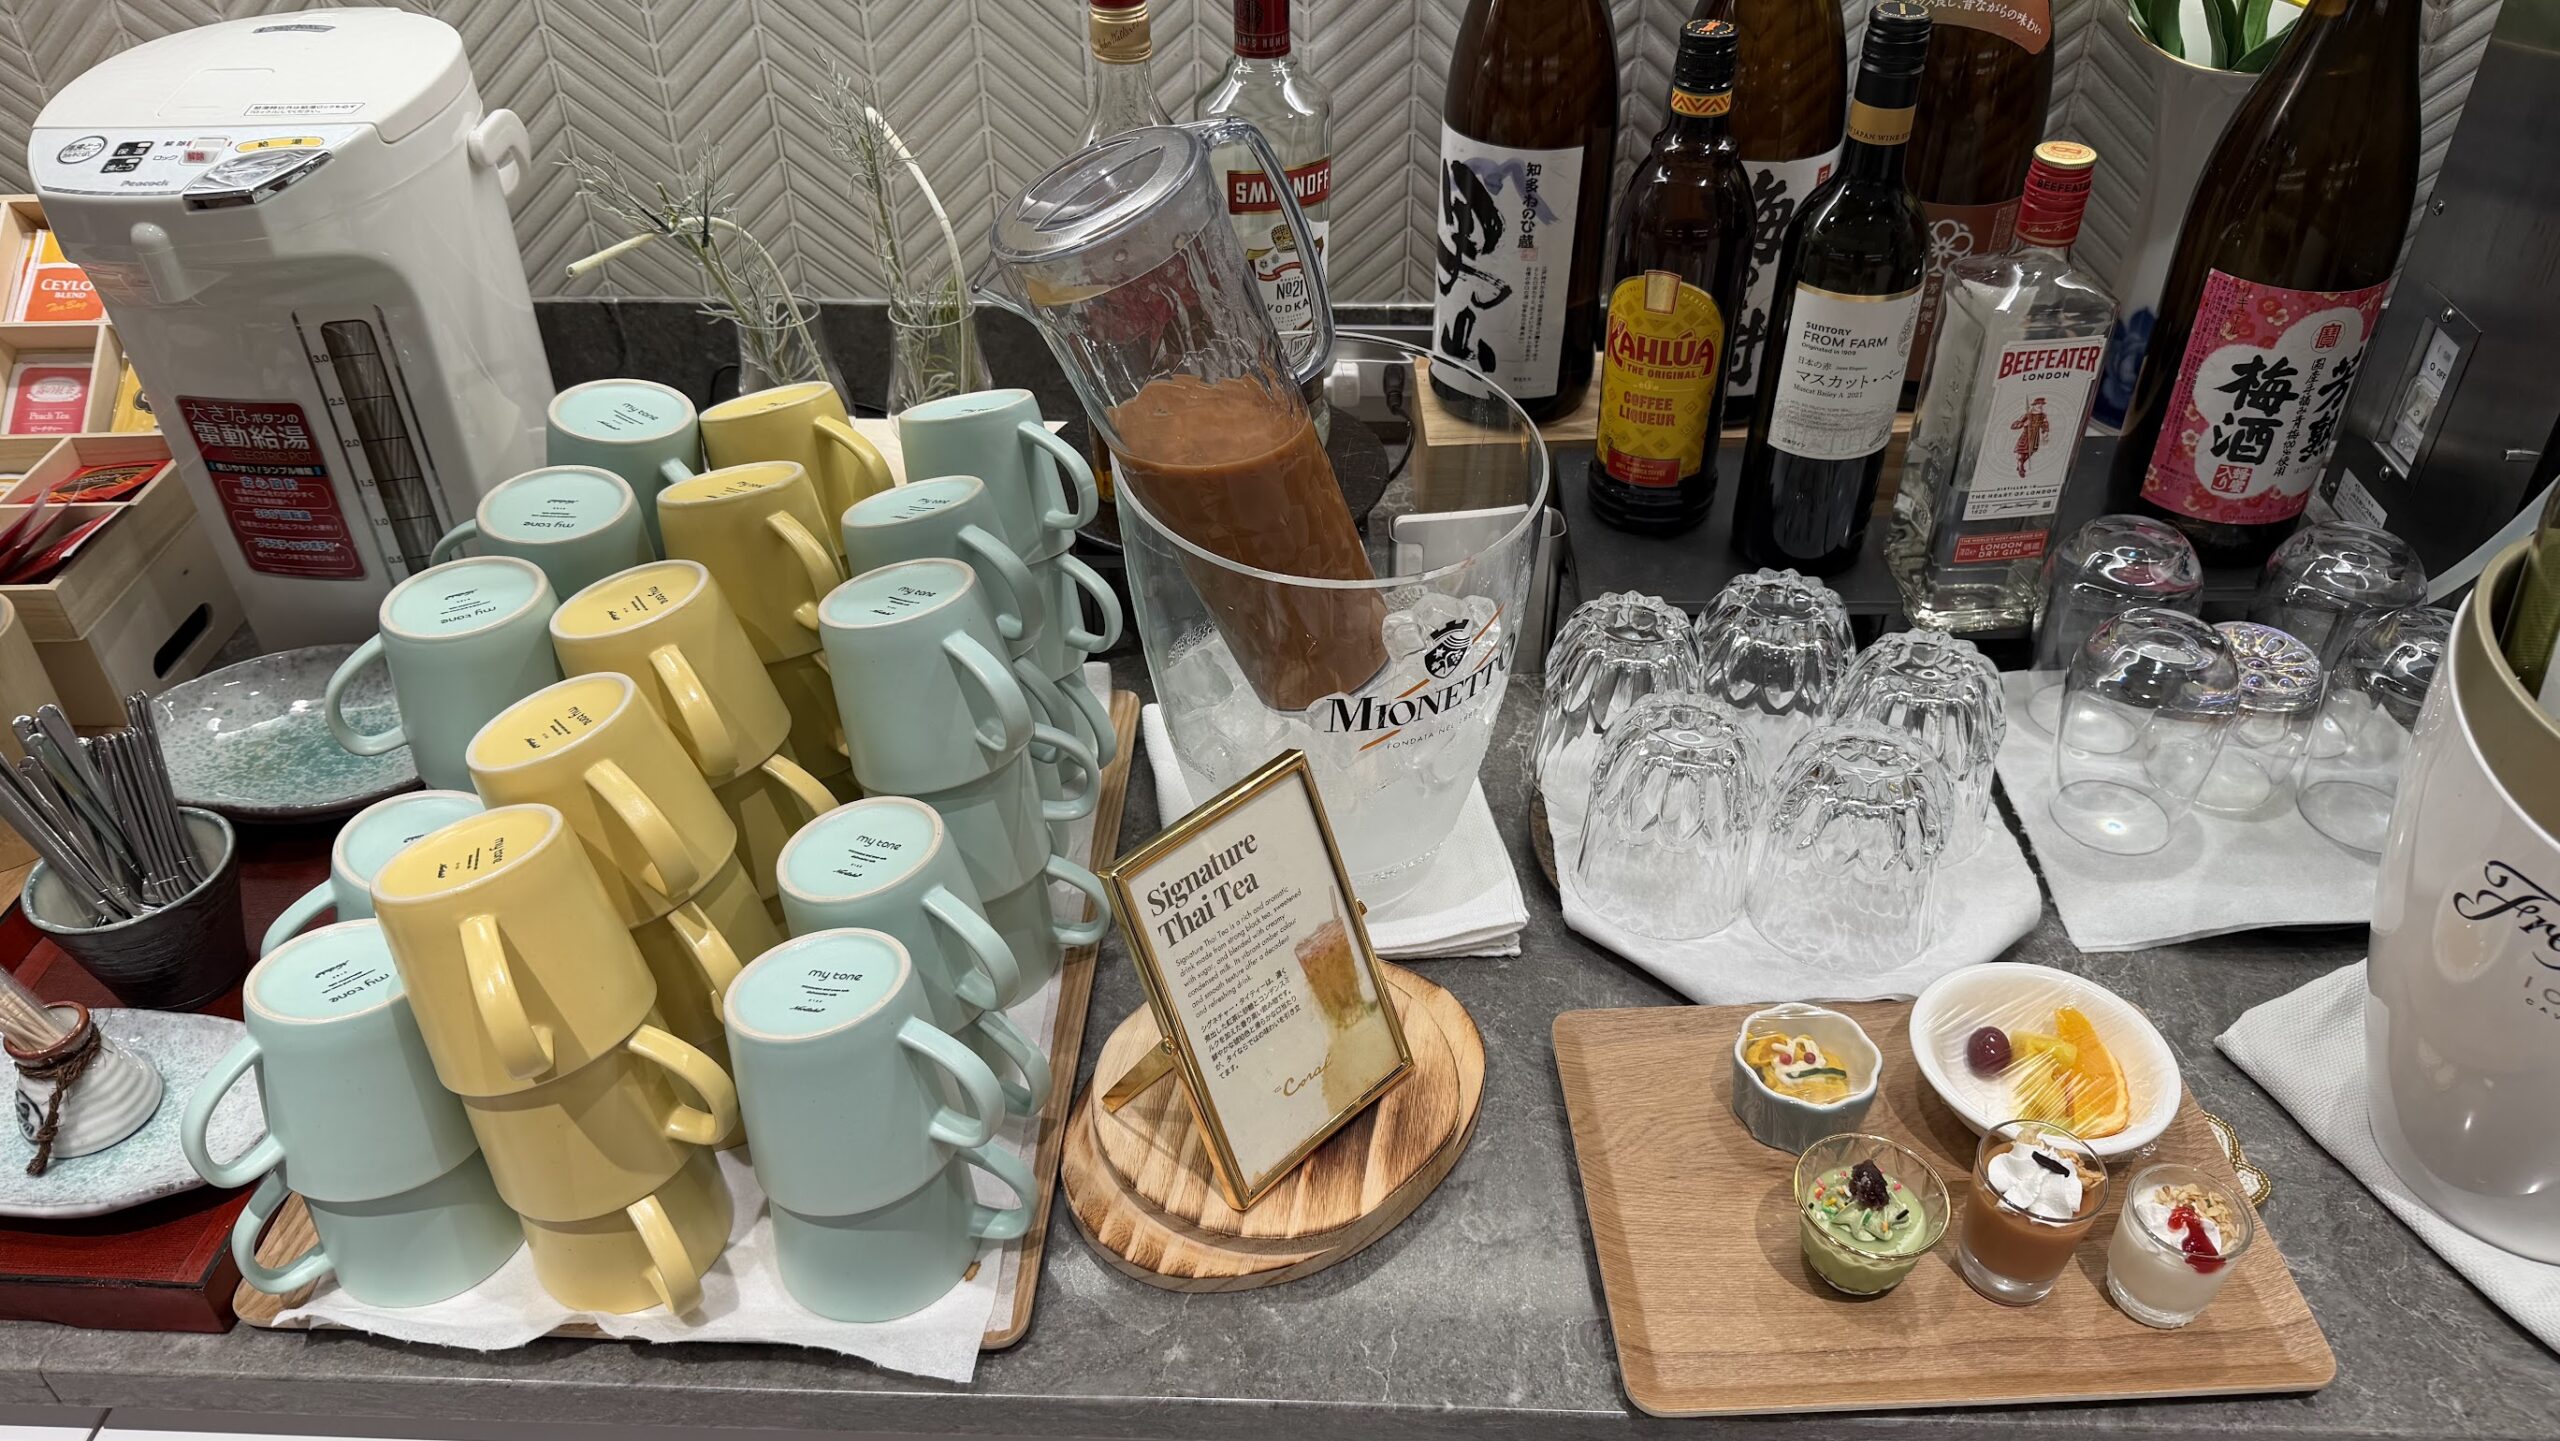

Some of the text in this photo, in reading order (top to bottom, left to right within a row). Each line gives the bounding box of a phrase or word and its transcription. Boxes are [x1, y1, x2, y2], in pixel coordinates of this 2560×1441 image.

[120, 180, 169, 188] Peacock
[41, 278, 95, 292] CEYLO
[54, 291, 86, 299] BLEND
[1267, 298, 1310, 314] VODKA
[1607, 314, 1716, 377] KAHLÚA
[1803, 330, 1888, 349] FROM FARM
[1801, 342, 1833, 355] Originated
[313, 354, 329, 363] 3.0
[1998, 345, 2102, 379] BEEFEATER
[1627, 364, 1697, 380] THE ORIGINAL
[2022, 371, 2070, 381] LONDON
[2437, 368, 2447, 381] OFF
[329, 398, 345, 407] 2.5
[1623, 390, 1673, 411] COFFEE
[55, 411, 70, 419] Tea
[1618, 404, 1676, 427] LIQUEUR
[2210, 354, 2300, 466] 梅酒
[193, 422, 309, 450] 電動給湯
[344, 438, 360, 448] 2.0
[360, 480, 375, 488] 1.5
[1987, 491, 2013, 499] HEART
[2025, 487, 2058, 497] LONDON
[374, 518, 389, 526] 1.0
[1980, 541, 2023, 552] LONDON
[2002, 548, 2021, 557] GIN
[388, 557, 404, 565] 0.5
[440, 606, 497, 625] my tone
[1323, 632, 1516, 733] MIONETTO
[856, 835, 902, 850] my tone
[1147, 834, 1258, 917] Signature
[1157, 872, 1260, 948] Thai Tea
[1175, 945, 1203, 966] Signature
[1216, 928, 1229, 937] Tea
[1240, 910, 1252, 920] rich
[1252, 901, 1264, 913] and
[1265, 887, 1288, 905] aromatic
[1180, 962, 1195, 977] drink
[1195, 951, 1212, 966] made
[1212, 942, 1226, 953] from
[1227, 929, 1245, 944] strong
[1244, 917, 1261, 932] black
[1273, 887, 1301, 912] sweetened
[1183, 974, 1196, 986] with
[1216, 951, 1228, 964] and
[1227, 934, 1251, 956] blended
[1252, 927, 1264, 938] with
[1265, 915, 1284, 930] creamy
[1187, 972, 1218, 997] condensed
[1242, 942, 1260, 959] vibrant
[1261, 930, 1278, 945] amber
[1279, 918, 1296, 932] colour
[808, 969, 863, 981] my tone
[1191, 994, 1203, 1008] and
[1204, 980, 1224, 999] smooth
[1224, 968, 1244, 984] texture
[1245, 958, 1257, 970] offer
[1264, 935, 1289, 956] decadent
[364, 973, 390, 987] my
[329, 986, 364, 1003] tone
[1195, 1004, 1207, 1017] and
[1208, 986, 1236, 1008] refreshing
[1283, 1052, 1333, 1096] Coral
